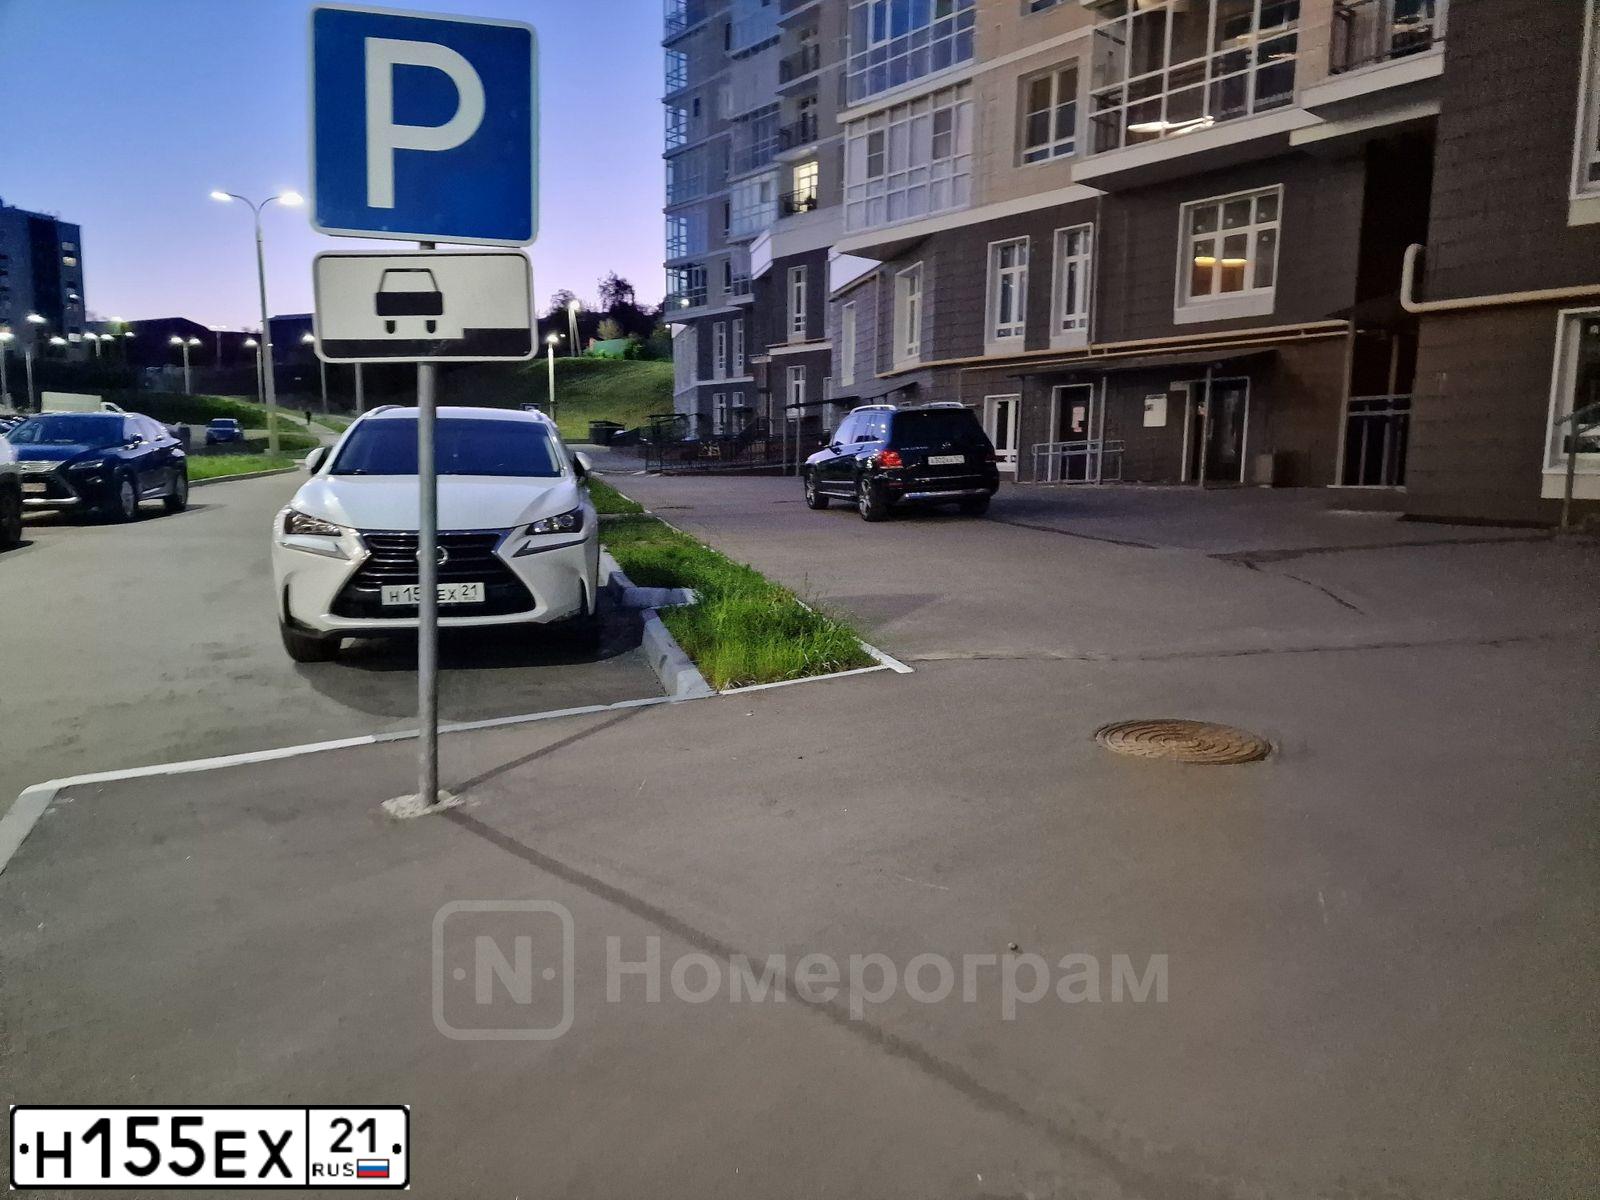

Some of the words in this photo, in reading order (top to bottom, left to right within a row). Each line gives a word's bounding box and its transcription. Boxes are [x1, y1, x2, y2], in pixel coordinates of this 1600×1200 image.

[365, 37, 486, 209] P
[389, 586, 457, 602] Н15ЕХ
[461, 584, 477, 596] 21
